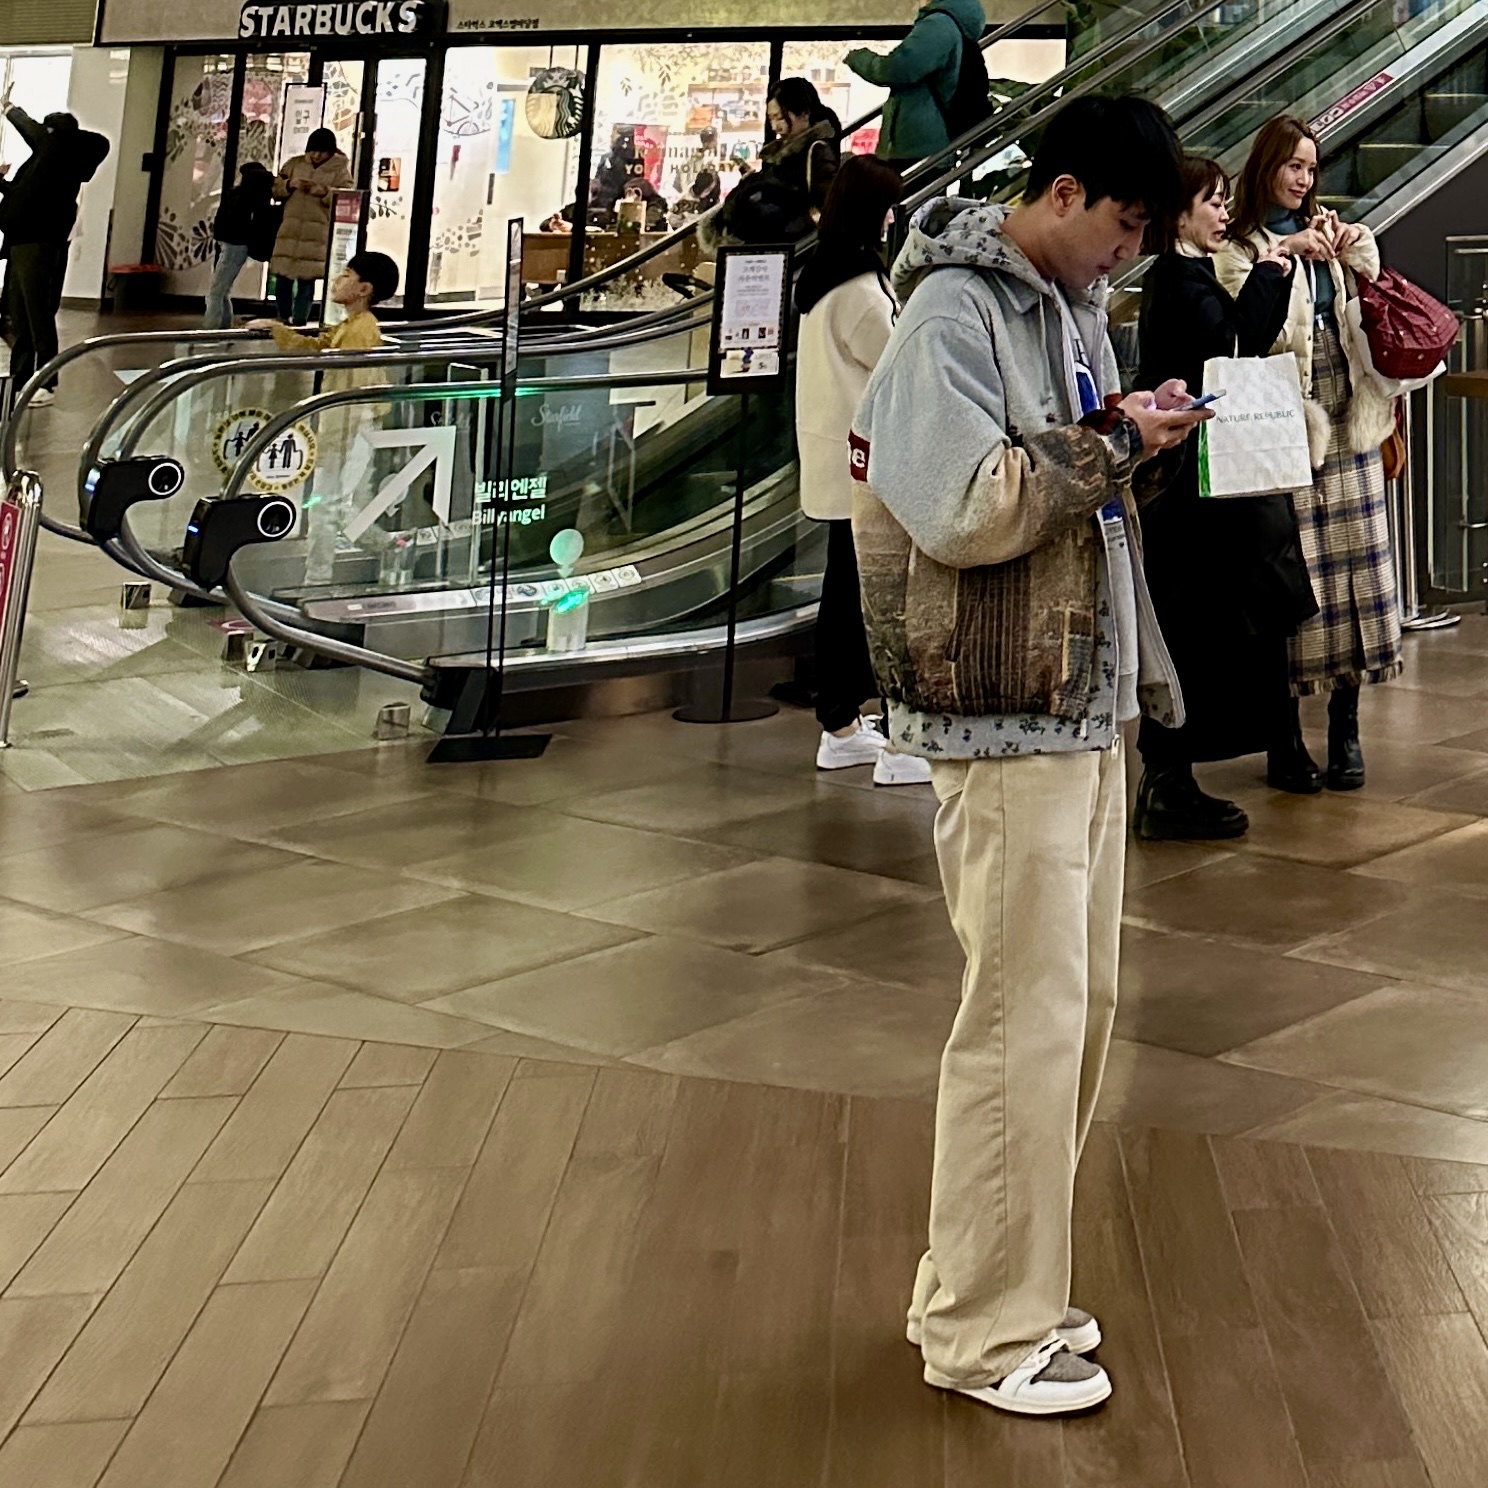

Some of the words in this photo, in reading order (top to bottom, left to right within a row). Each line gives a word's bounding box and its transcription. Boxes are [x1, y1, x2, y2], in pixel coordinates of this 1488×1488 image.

[239, 0, 425, 39] STARBUCKS
[1216, 413, 1250, 424] NATURE
[1253, 409, 1296, 421] REPUBLIC
